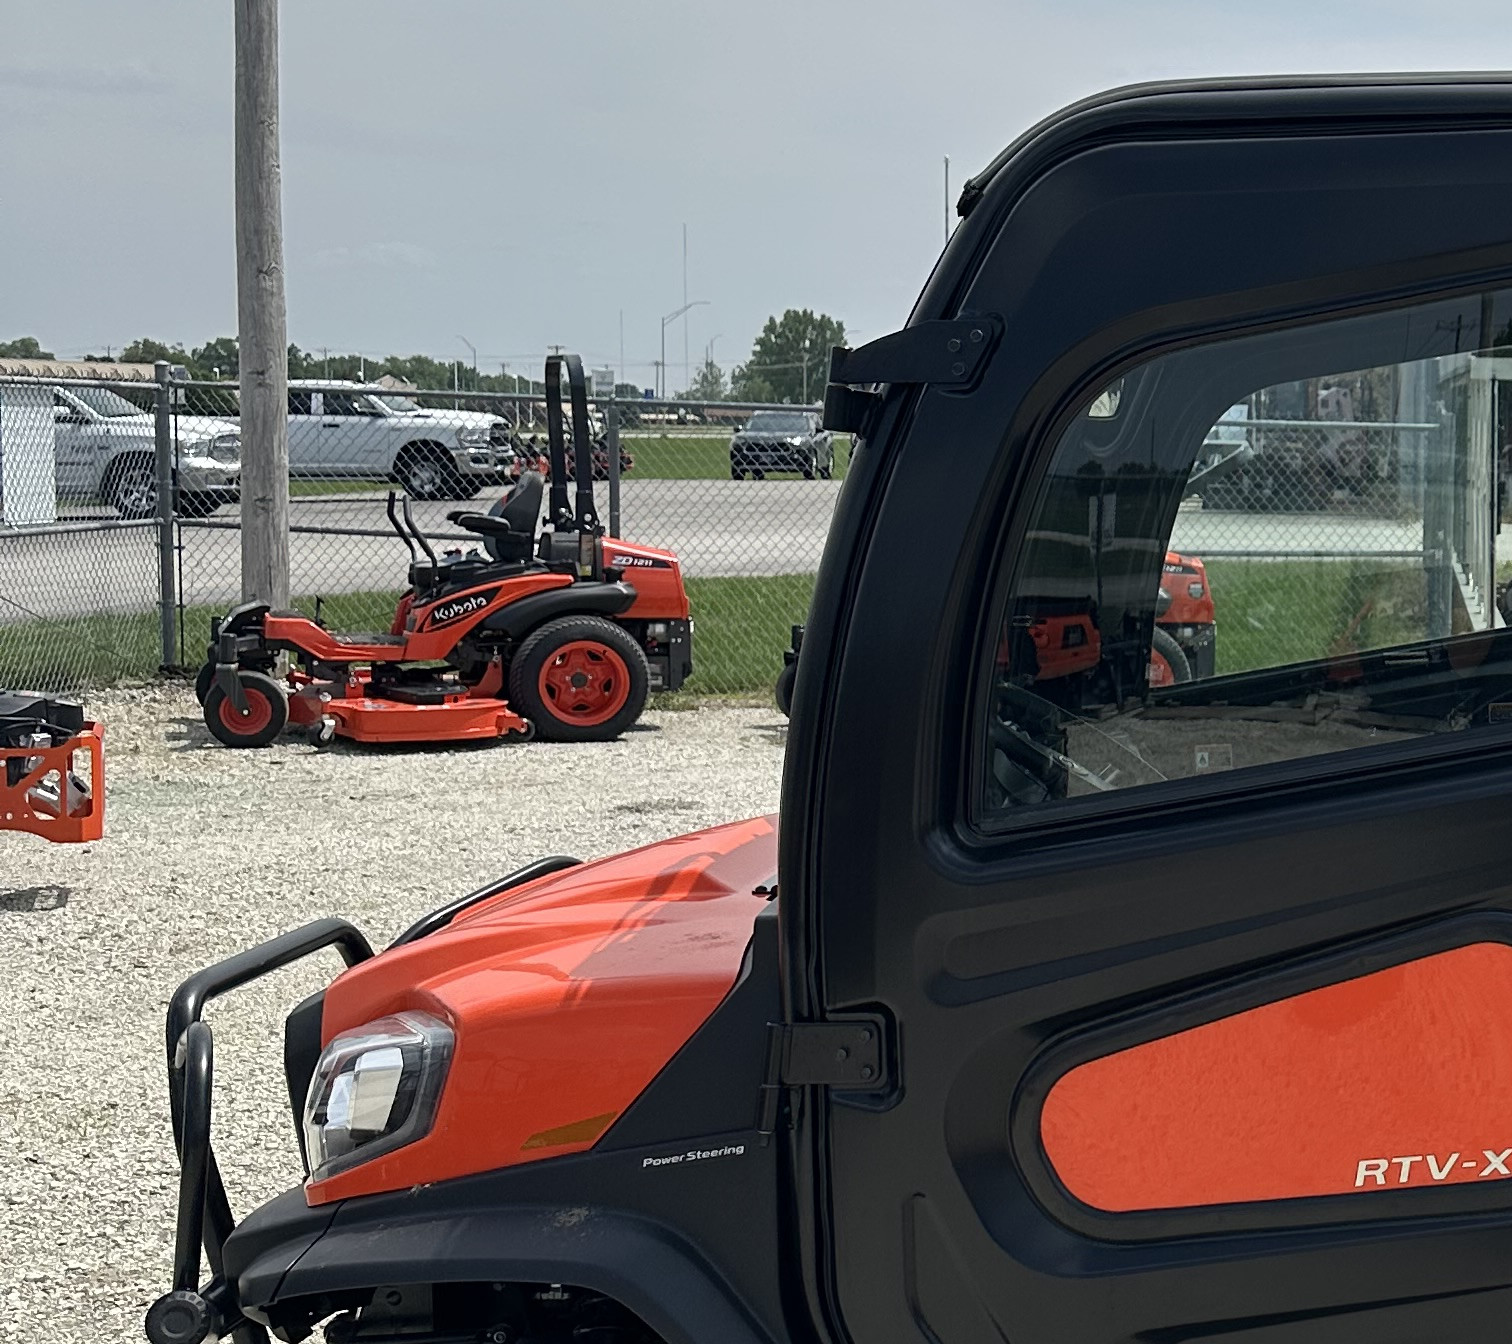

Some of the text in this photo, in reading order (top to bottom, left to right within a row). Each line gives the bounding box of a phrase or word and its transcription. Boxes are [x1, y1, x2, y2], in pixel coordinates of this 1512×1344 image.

[434, 597, 488, 620] Kubota
[642, 1145, 744, 1167] Power Steering
